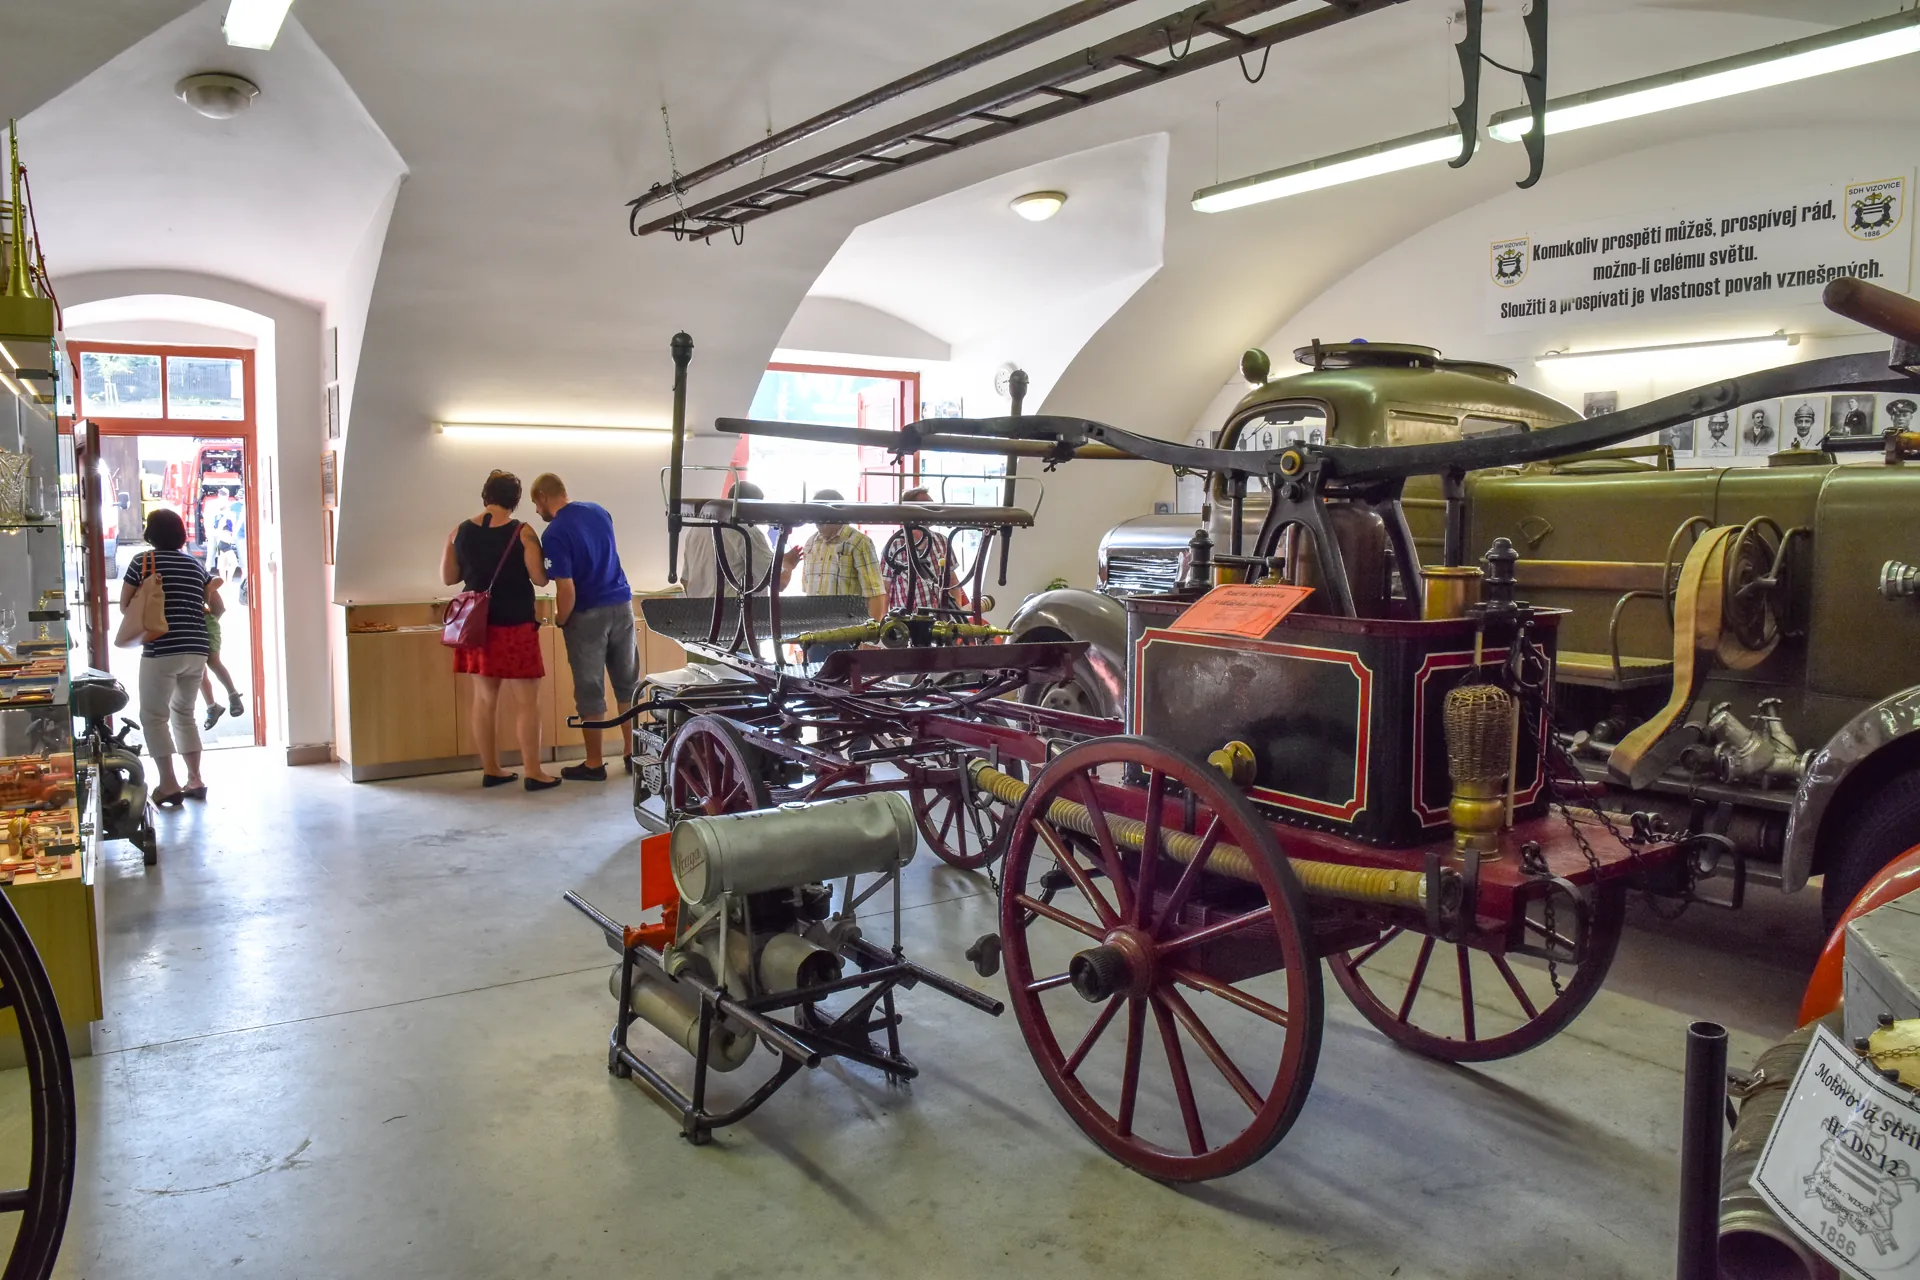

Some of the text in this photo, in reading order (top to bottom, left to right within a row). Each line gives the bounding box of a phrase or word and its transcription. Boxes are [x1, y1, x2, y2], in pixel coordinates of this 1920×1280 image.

[1849, 181, 1900, 195] SDH VIZOVICE
[1533, 200, 1836, 261] Komukoliv prospěti můžeš, prospívej rád,
[1593, 244, 1757, 280] možno-li celému světu.
[1500, 258, 1884, 319] Sloužiti a prospívati je vlastnost povah vznešených.
[1815, 1063, 1877, 1124] Motorová
[1851, 1134, 1874, 1160] DS
[1880, 1154, 1899, 1176] 12
[1820, 1221, 1857, 1257] 1886
